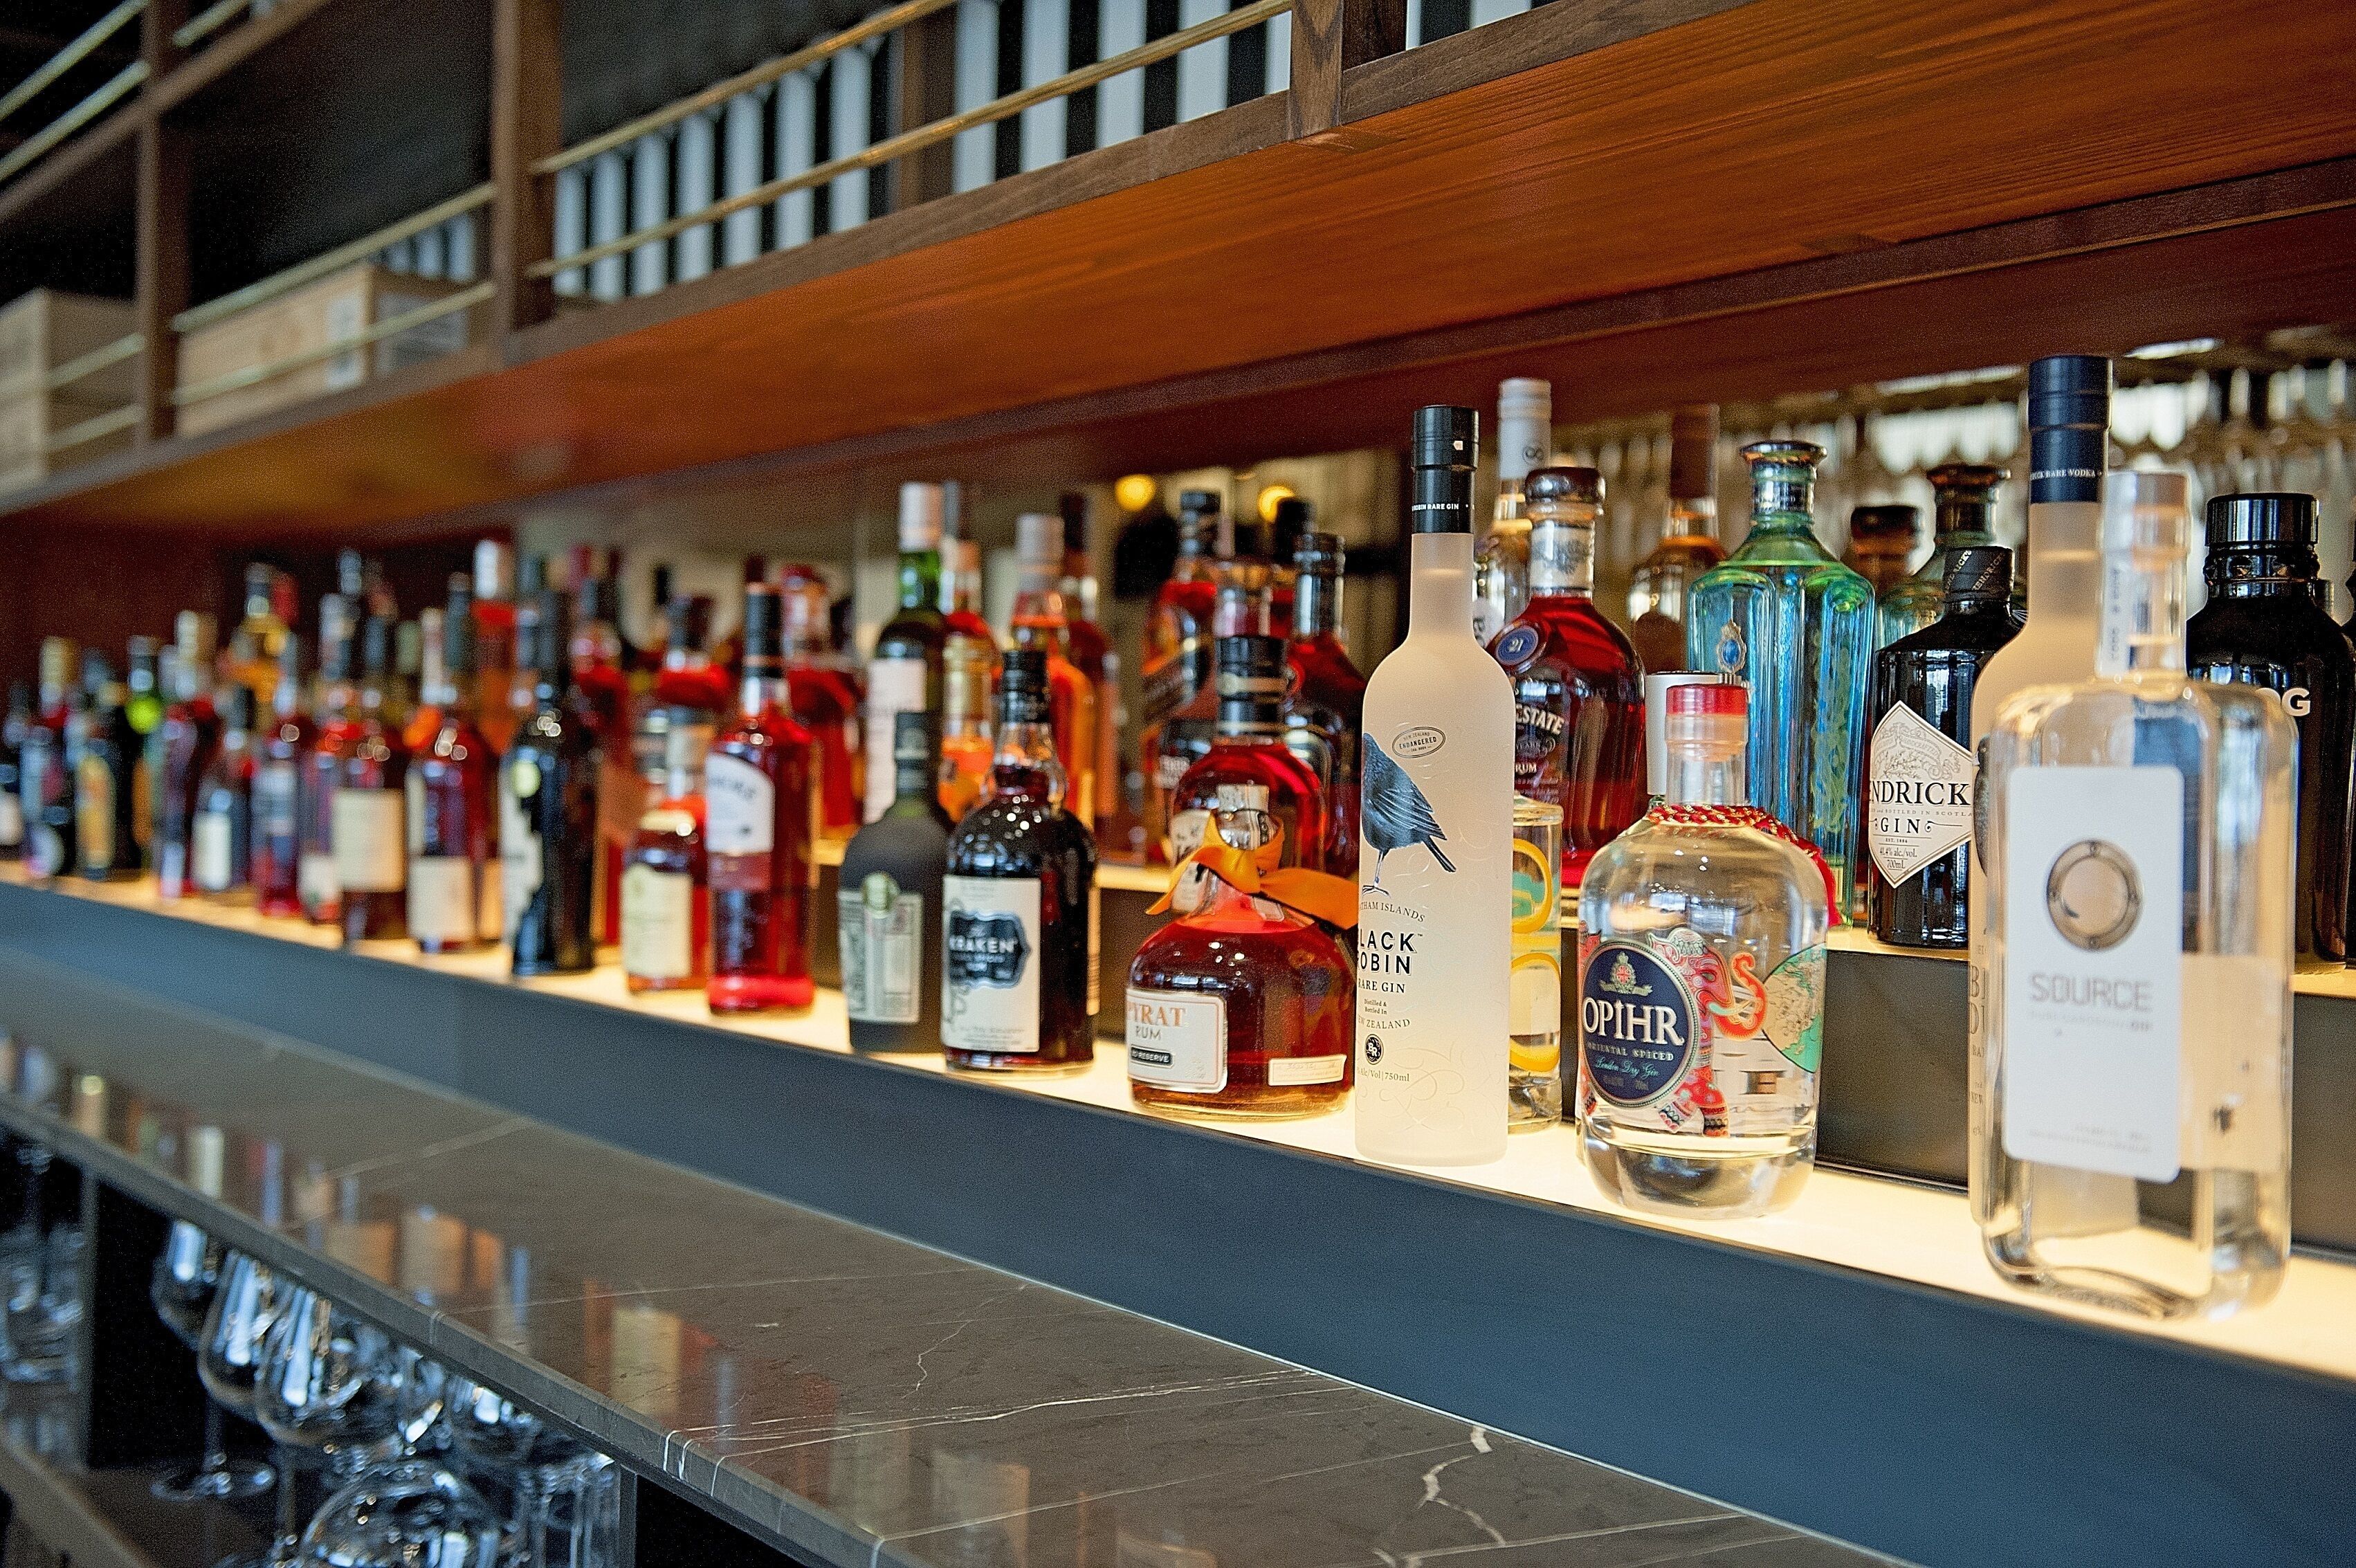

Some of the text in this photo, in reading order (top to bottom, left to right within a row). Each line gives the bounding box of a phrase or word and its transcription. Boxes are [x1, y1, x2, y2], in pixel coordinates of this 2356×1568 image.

[2045, 469, 2067, 478] RARE
[2068, 468, 2096, 478] VODKA
[1515, 704, 1564, 735] ESTATE
[1399, 736, 1437, 749] ENDANGERED
[1515, 763, 1537, 774] RUM
[1870, 780, 1971, 805] NDRICK
[1881, 817, 1921, 834] GIN
[1381, 903, 1425, 922] ISLANDS
[949, 936, 1014, 954] KRAKEN
[1360, 929, 1416, 954] LACK
[1359, 951, 1411, 975] OBIN
[1358, 978, 1405, 994] RARE GIN
[2030, 972, 2153, 1013] SOURCE
[1364, 999, 1382, 1007] Distilled
[1367, 1019, 1411, 1029] ZEALAND
[1585, 996, 1685, 1046] OPIHR
[1135, 1025, 1162, 1040] RUM
[1138, 1050, 1169, 1062] RESERVE
[1632, 1048, 1674, 1061] SPICED
[1595, 1056, 1659, 1080] London Dry Gin
